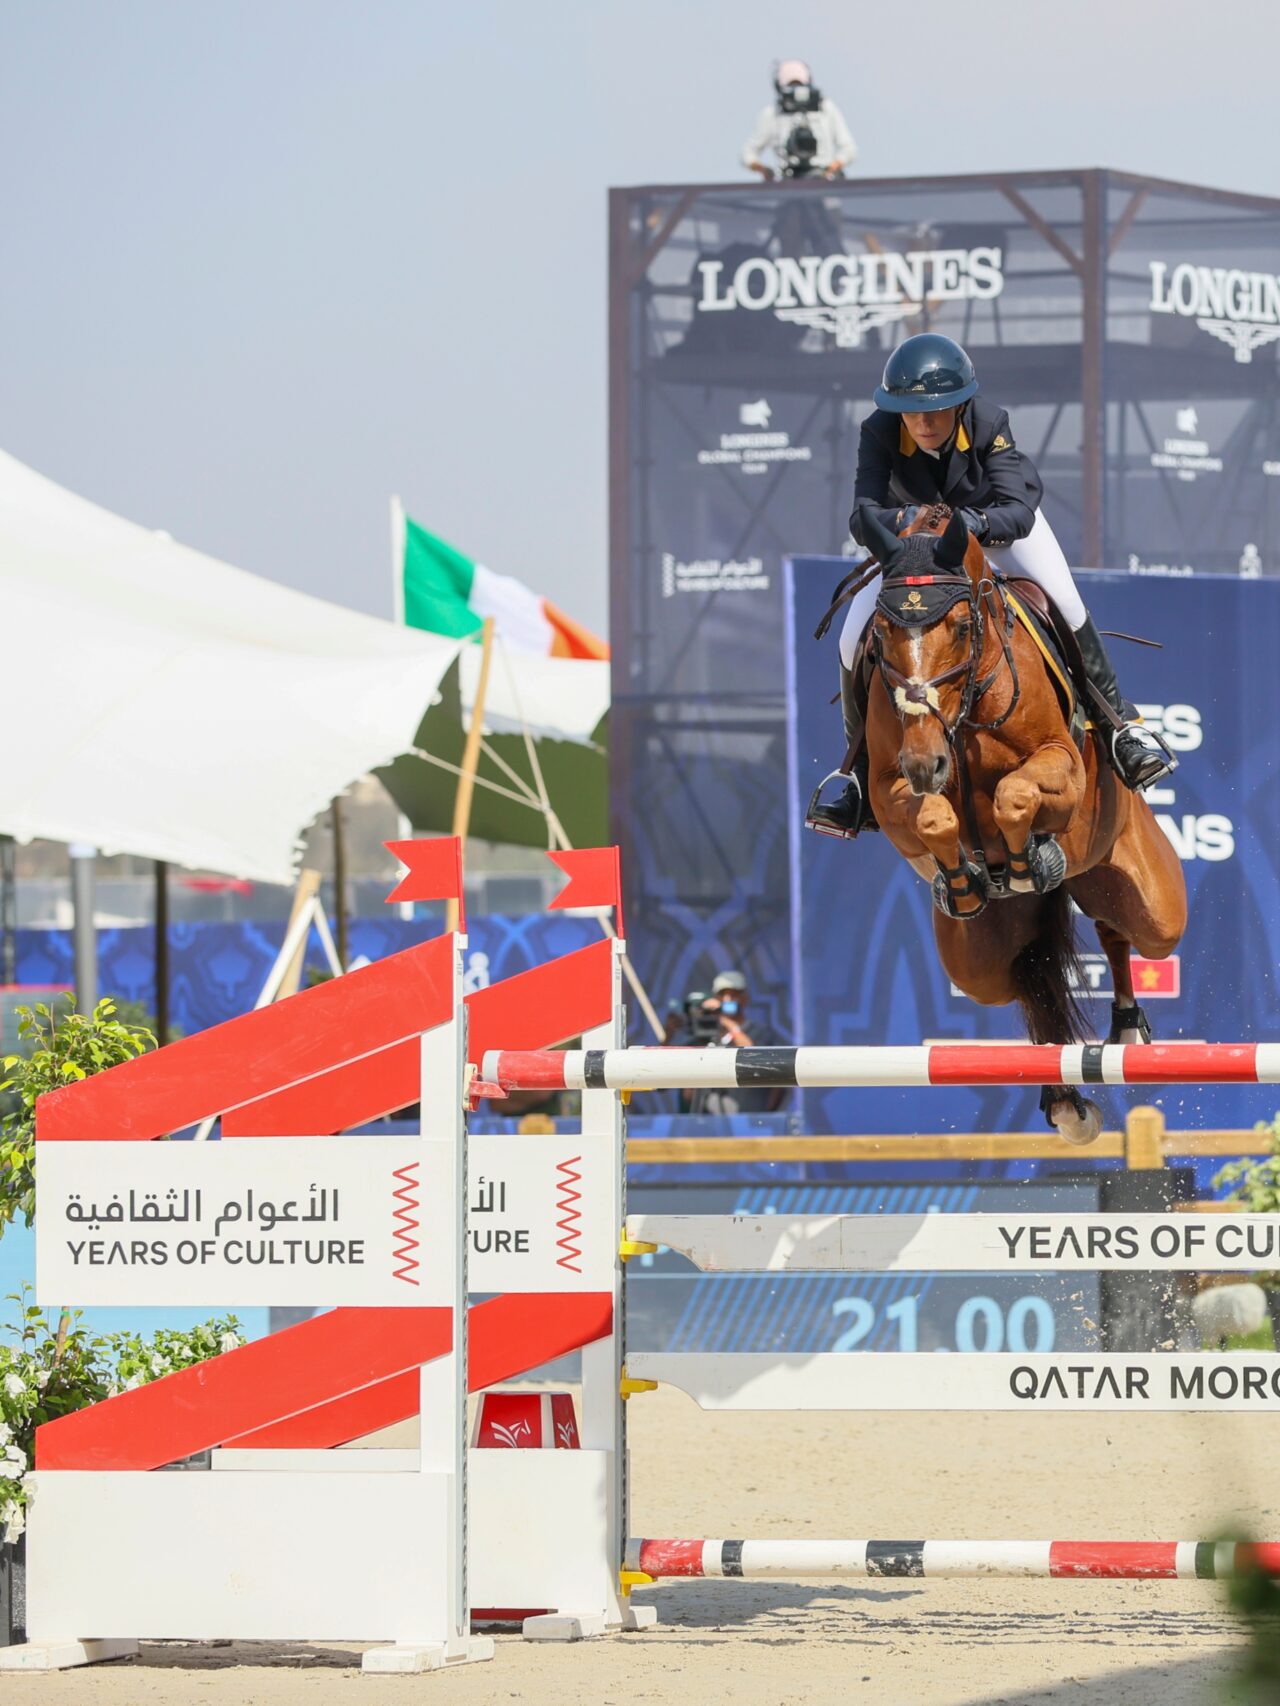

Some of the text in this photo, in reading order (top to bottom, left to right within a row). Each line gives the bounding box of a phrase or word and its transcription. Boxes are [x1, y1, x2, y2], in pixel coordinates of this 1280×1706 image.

[698, 247, 1003, 311] LONGINES
[66, 1183, 339, 1237] الأعوام الثقافية
[66, 1240, 365, 1265] YEARS OF CULTURE
[468, 1230, 530, 1253] URE
[998, 1225, 1140, 1259] YEARS
[1150, 1225, 1206, 1258] OF
[1009, 1366, 1150, 1400] QATAR
